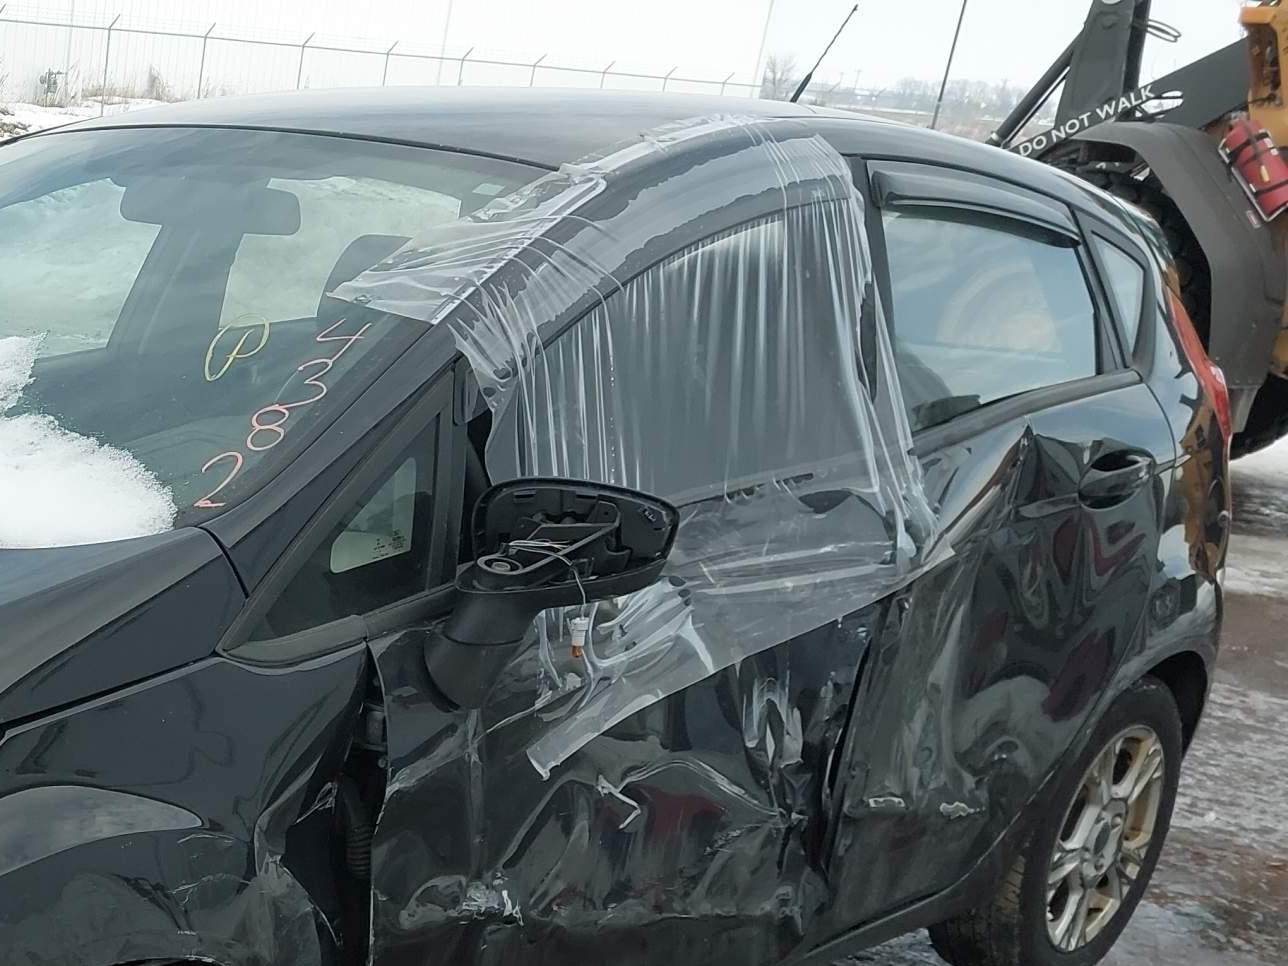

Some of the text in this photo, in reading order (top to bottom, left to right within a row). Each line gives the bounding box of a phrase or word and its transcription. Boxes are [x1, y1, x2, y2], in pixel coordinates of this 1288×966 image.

[1018, 84, 1156, 157] DO NOT WALK
